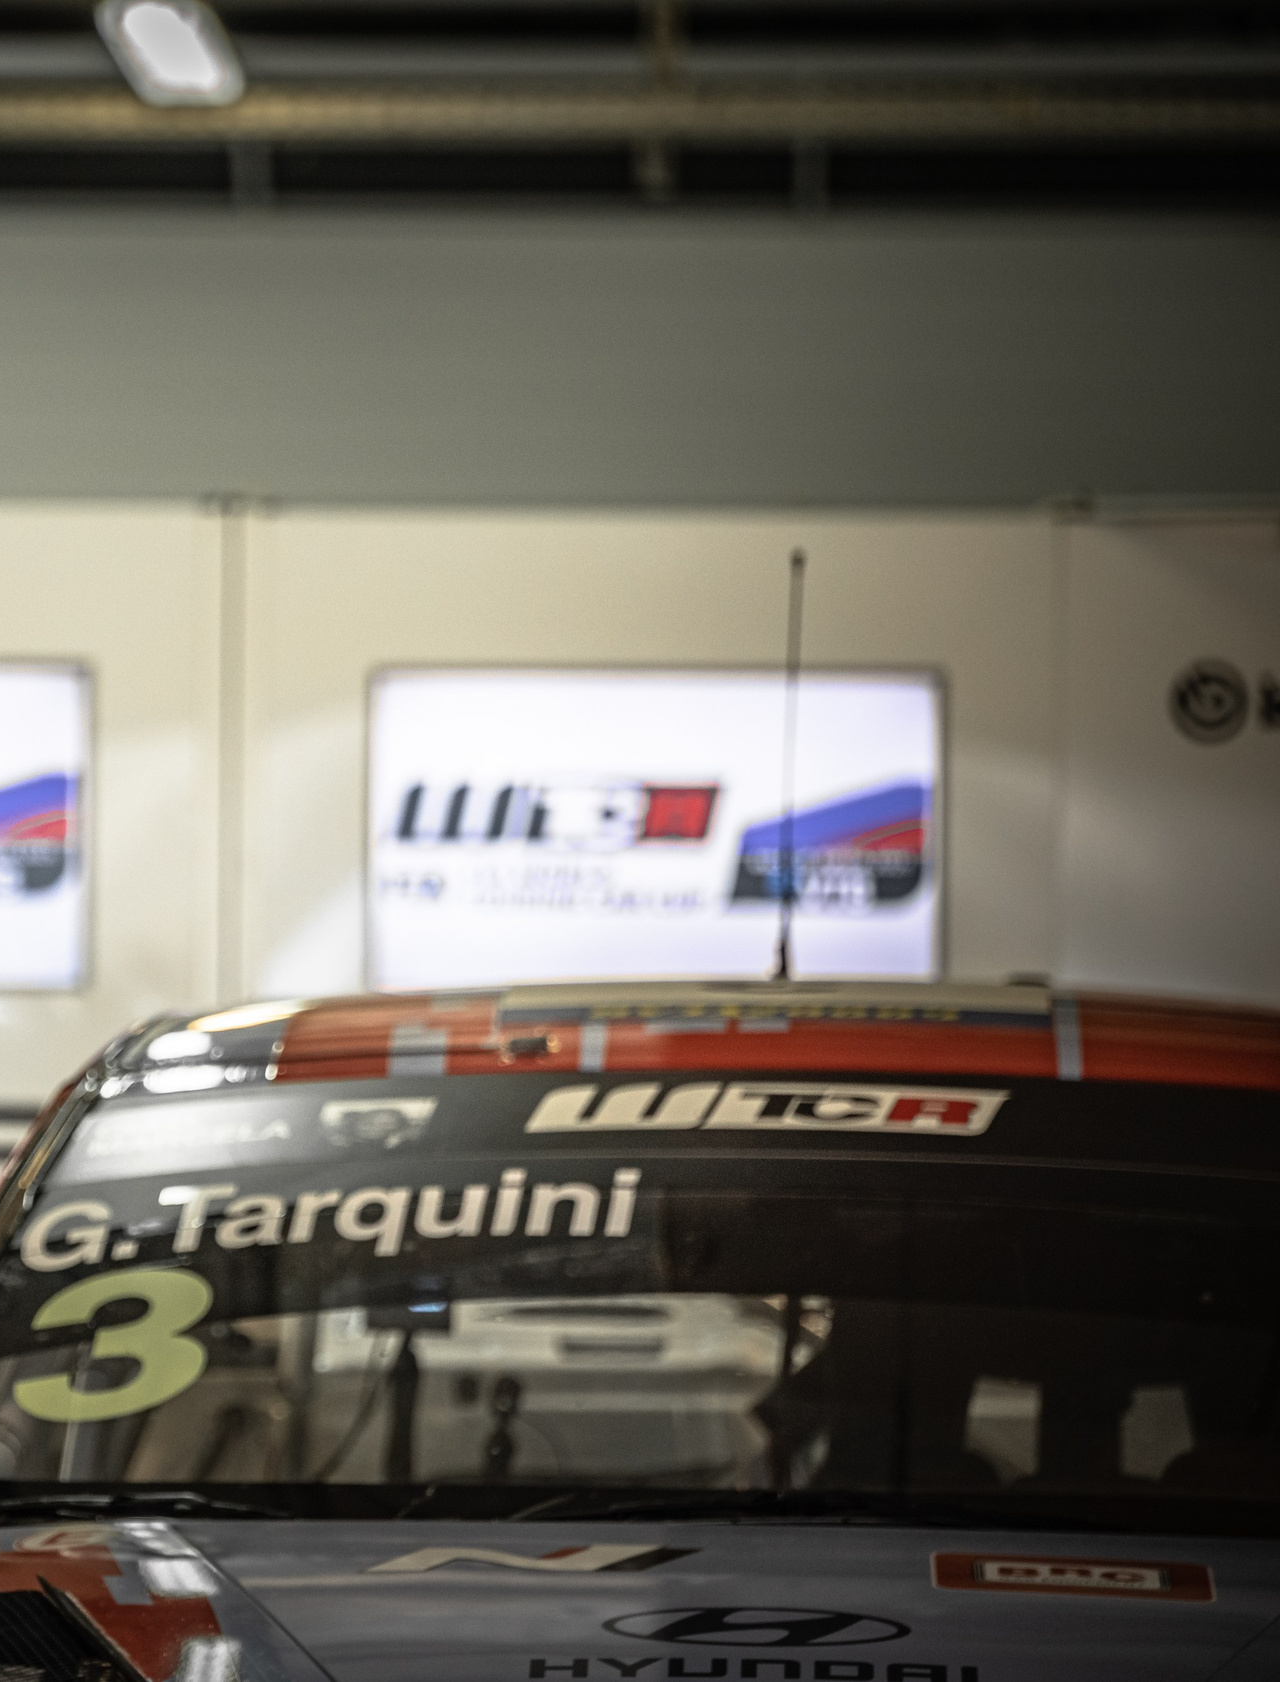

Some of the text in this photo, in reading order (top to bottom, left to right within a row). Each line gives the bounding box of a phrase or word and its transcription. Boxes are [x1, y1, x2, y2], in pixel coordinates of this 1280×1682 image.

[525, 1081, 1010, 1137] WTCR
[19, 1167, 641, 1272] G. Tarquini
[12, 1266, 214, 1423] 3
